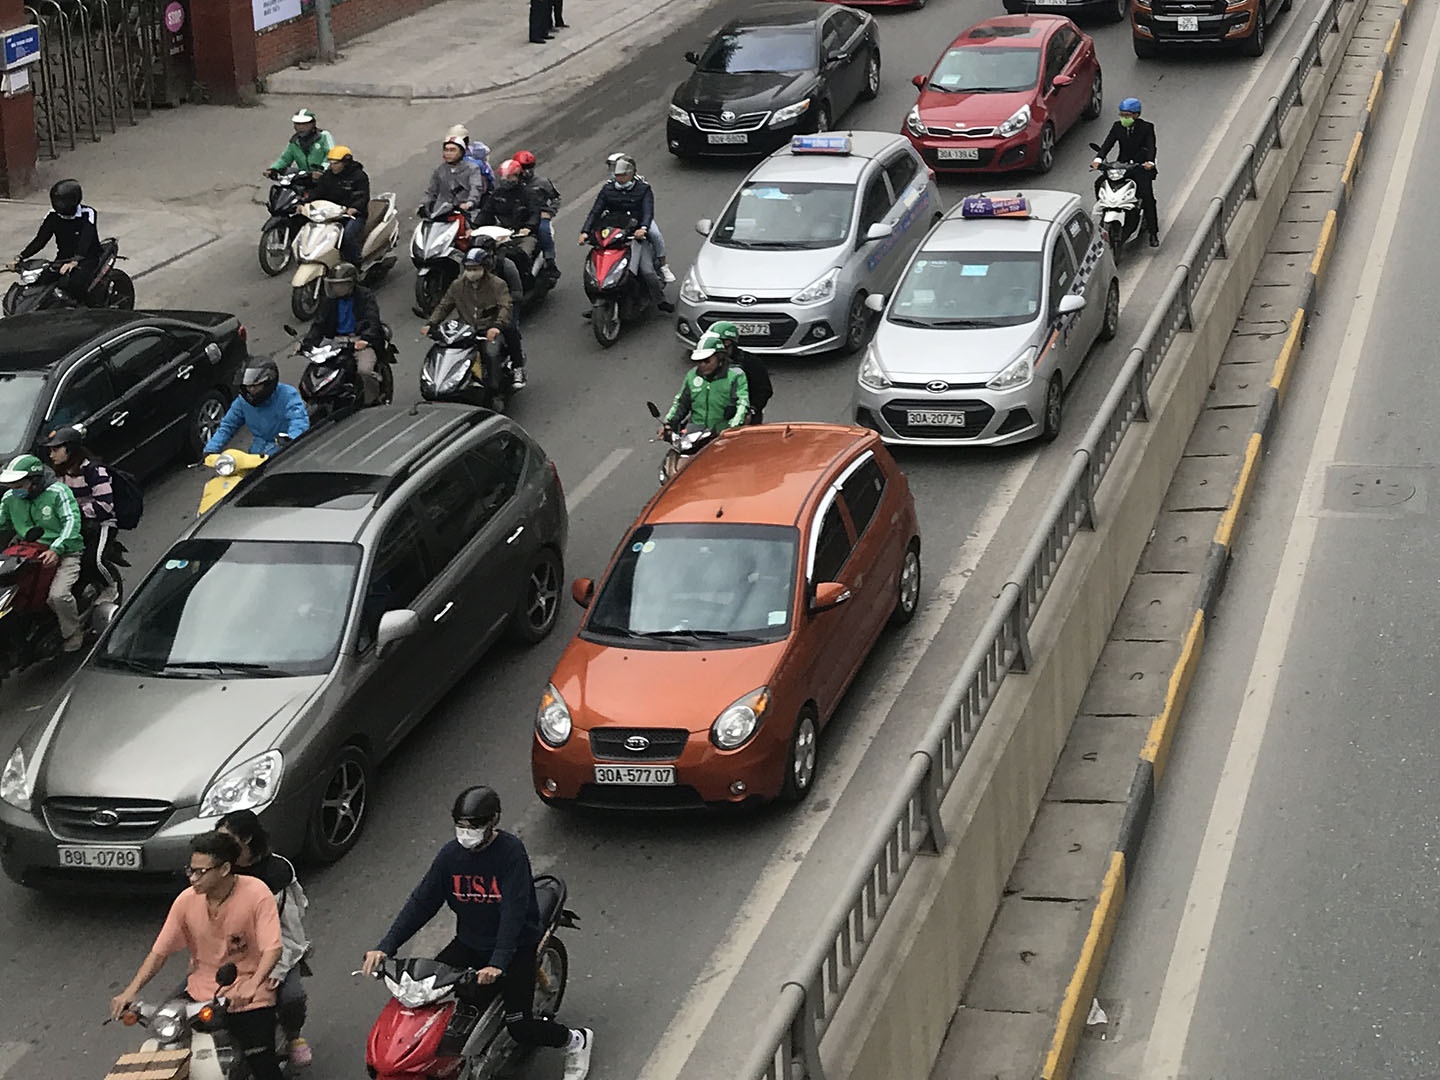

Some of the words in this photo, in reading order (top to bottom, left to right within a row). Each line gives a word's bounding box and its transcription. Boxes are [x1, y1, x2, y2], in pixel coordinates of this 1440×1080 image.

[168, 9, 182, 25] STOP
[64, 849, 135, 867] 89L-0789
[452, 874, 502, 903] USA
